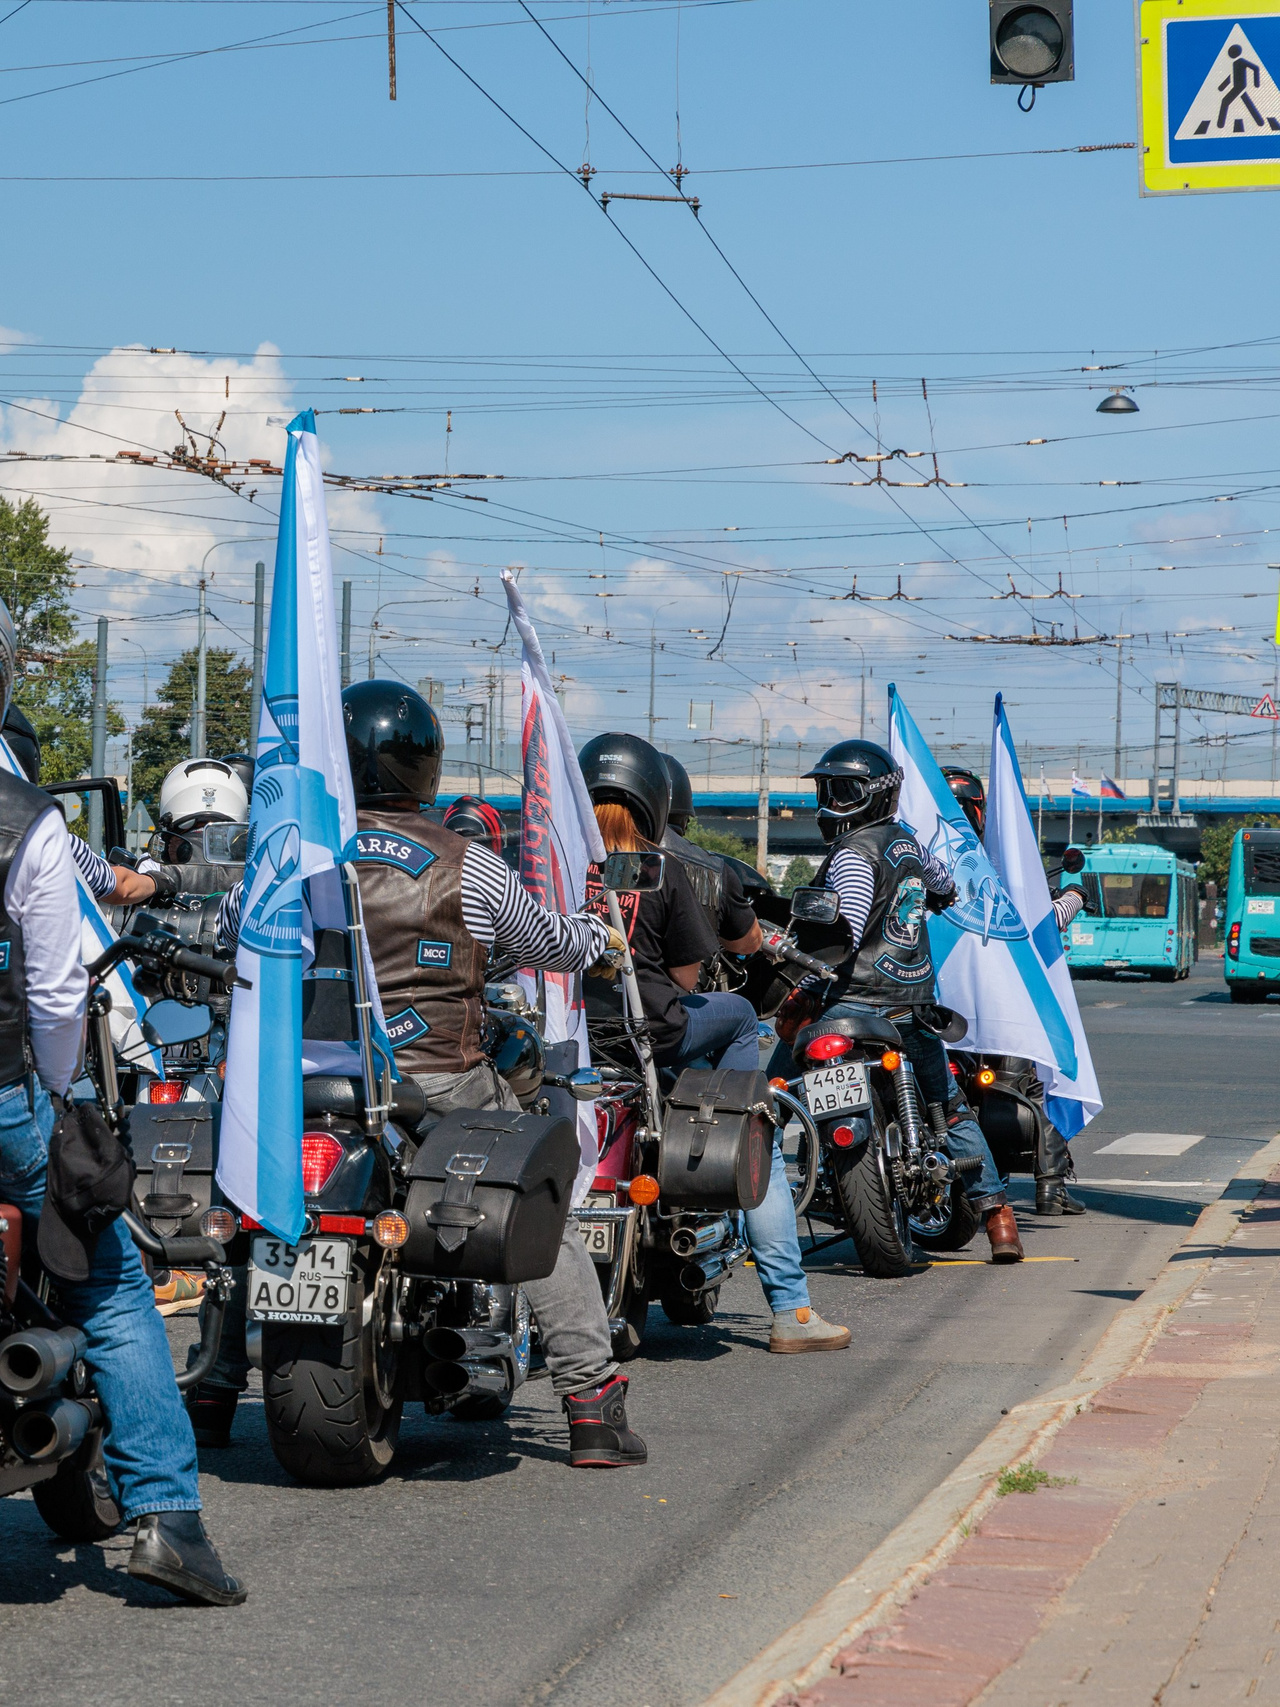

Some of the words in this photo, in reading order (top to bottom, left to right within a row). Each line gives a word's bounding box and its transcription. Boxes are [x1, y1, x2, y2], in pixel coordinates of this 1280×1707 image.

[357, 838, 411, 860] ARKS
[423, 948, 446, 959] MCC
[813, 1066, 857, 1088] 4482
[836, 1082, 850, 1091] RUS
[813, 1094, 837, 1113] AB
[843, 1087, 863, 1104] 47
[580, 1221, 592, 1229] US
[580, 1229, 605, 1250] 78
[265, 1242, 335, 1270] 3514
[300, 1271, 322, 1281] RUS
[254, 1281, 295, 1307] AO
[306, 1284, 339, 1309] 78
[267, 1311, 324, 1323] HONDA
